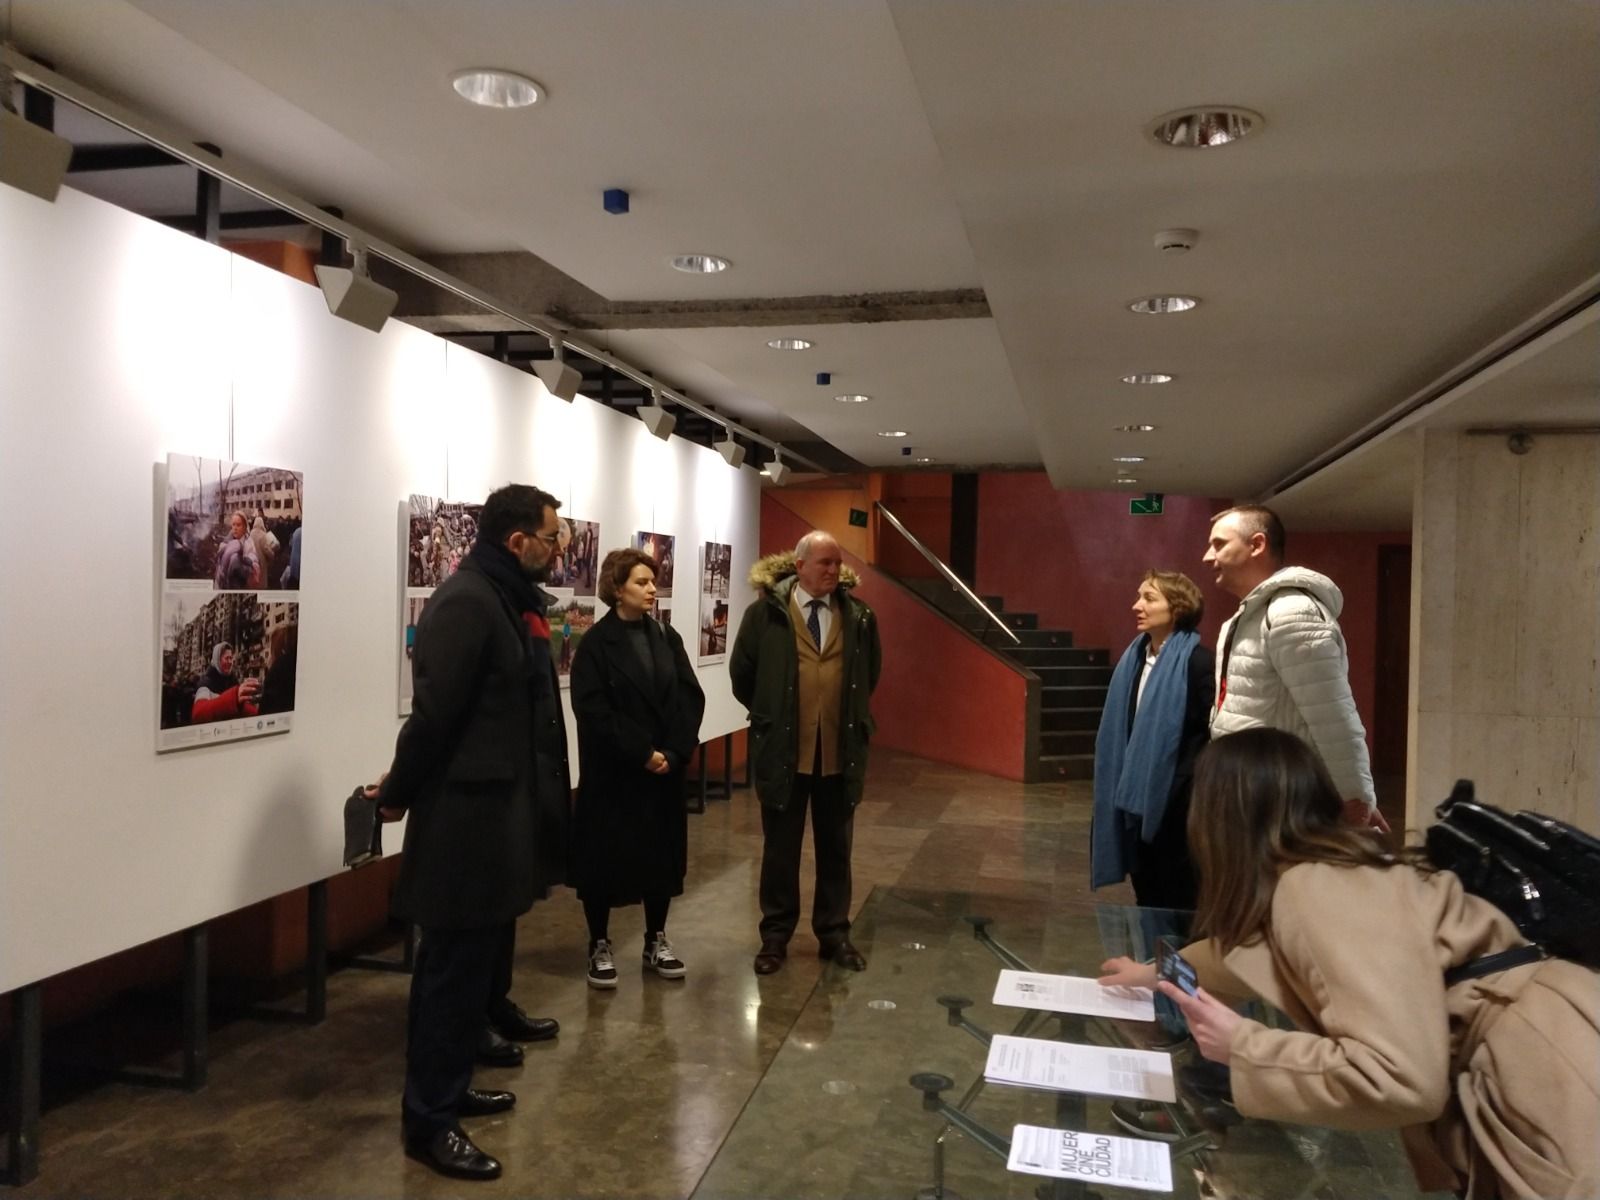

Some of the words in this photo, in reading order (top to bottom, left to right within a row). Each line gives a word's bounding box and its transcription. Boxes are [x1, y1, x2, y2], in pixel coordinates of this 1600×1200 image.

[1061, 1131, 1078, 1173] MUJER
[1078, 1150, 1094, 1175] CINE
[1095, 1137, 1111, 1177] CIUDAD
